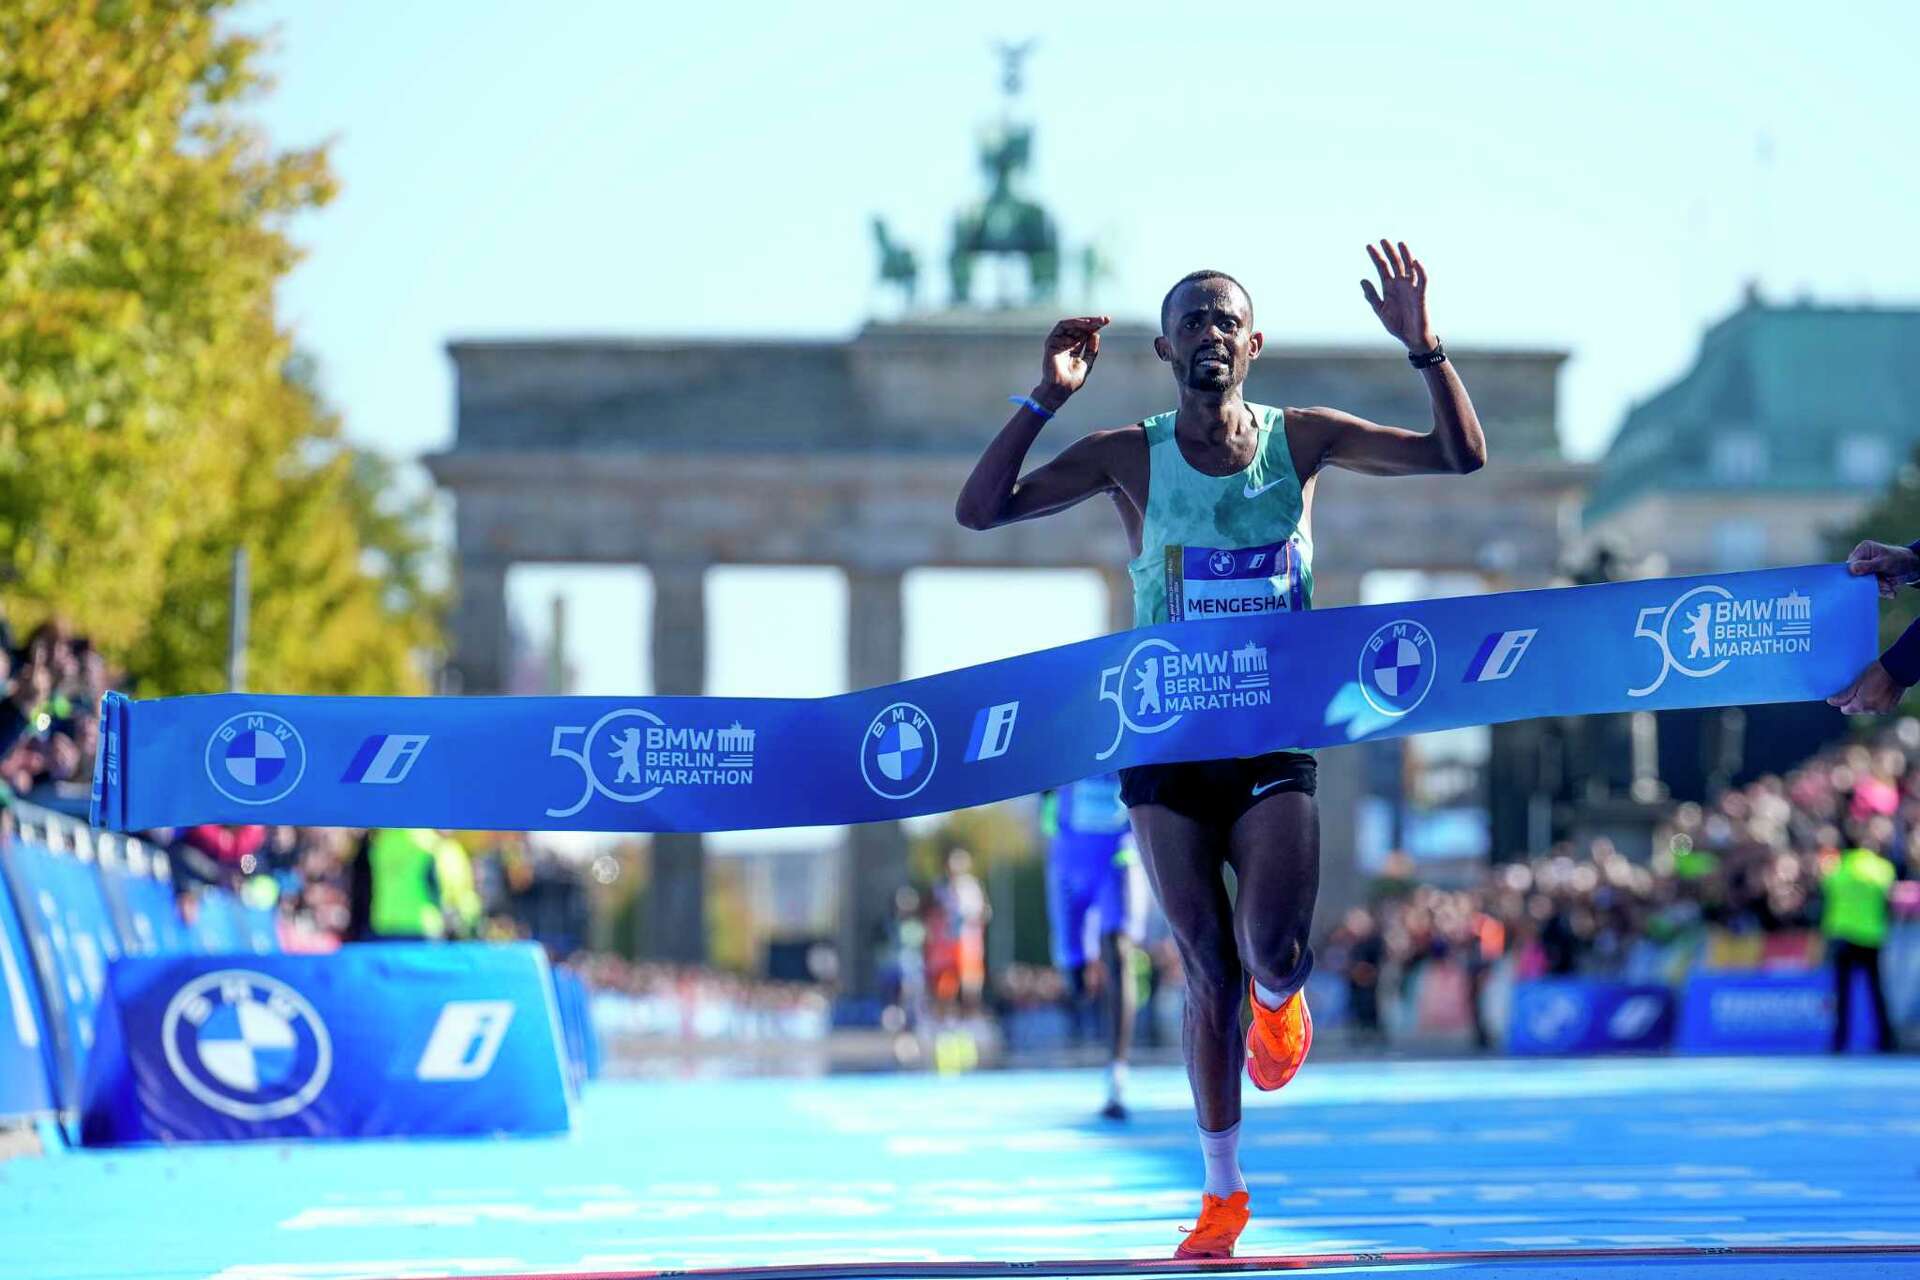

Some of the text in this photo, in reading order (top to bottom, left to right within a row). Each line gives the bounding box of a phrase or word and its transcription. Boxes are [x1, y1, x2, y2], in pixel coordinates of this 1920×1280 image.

[1188, 595, 1287, 613] MENGESHA
[1715, 599, 1774, 622] BMW
[1370, 625, 1427, 652] BMW
[1627, 585, 1735, 697] 50
[1714, 624, 1773, 639] BERLIN
[1714, 638, 1810, 657] MARATHON
[1163, 651, 1229, 677] BMW
[1164, 676, 1231, 695] BERLIN
[1096, 638, 1183, 761] 50
[1165, 690, 1271, 712] MARATHON
[220, 716, 293, 742] BMW
[872, 708, 926, 738] BMW
[646, 728, 714, 750] BMW
[545, 708, 668, 818] 50
[646, 752, 714, 767] BERLIN
[646, 770, 753, 785] MARATHON
